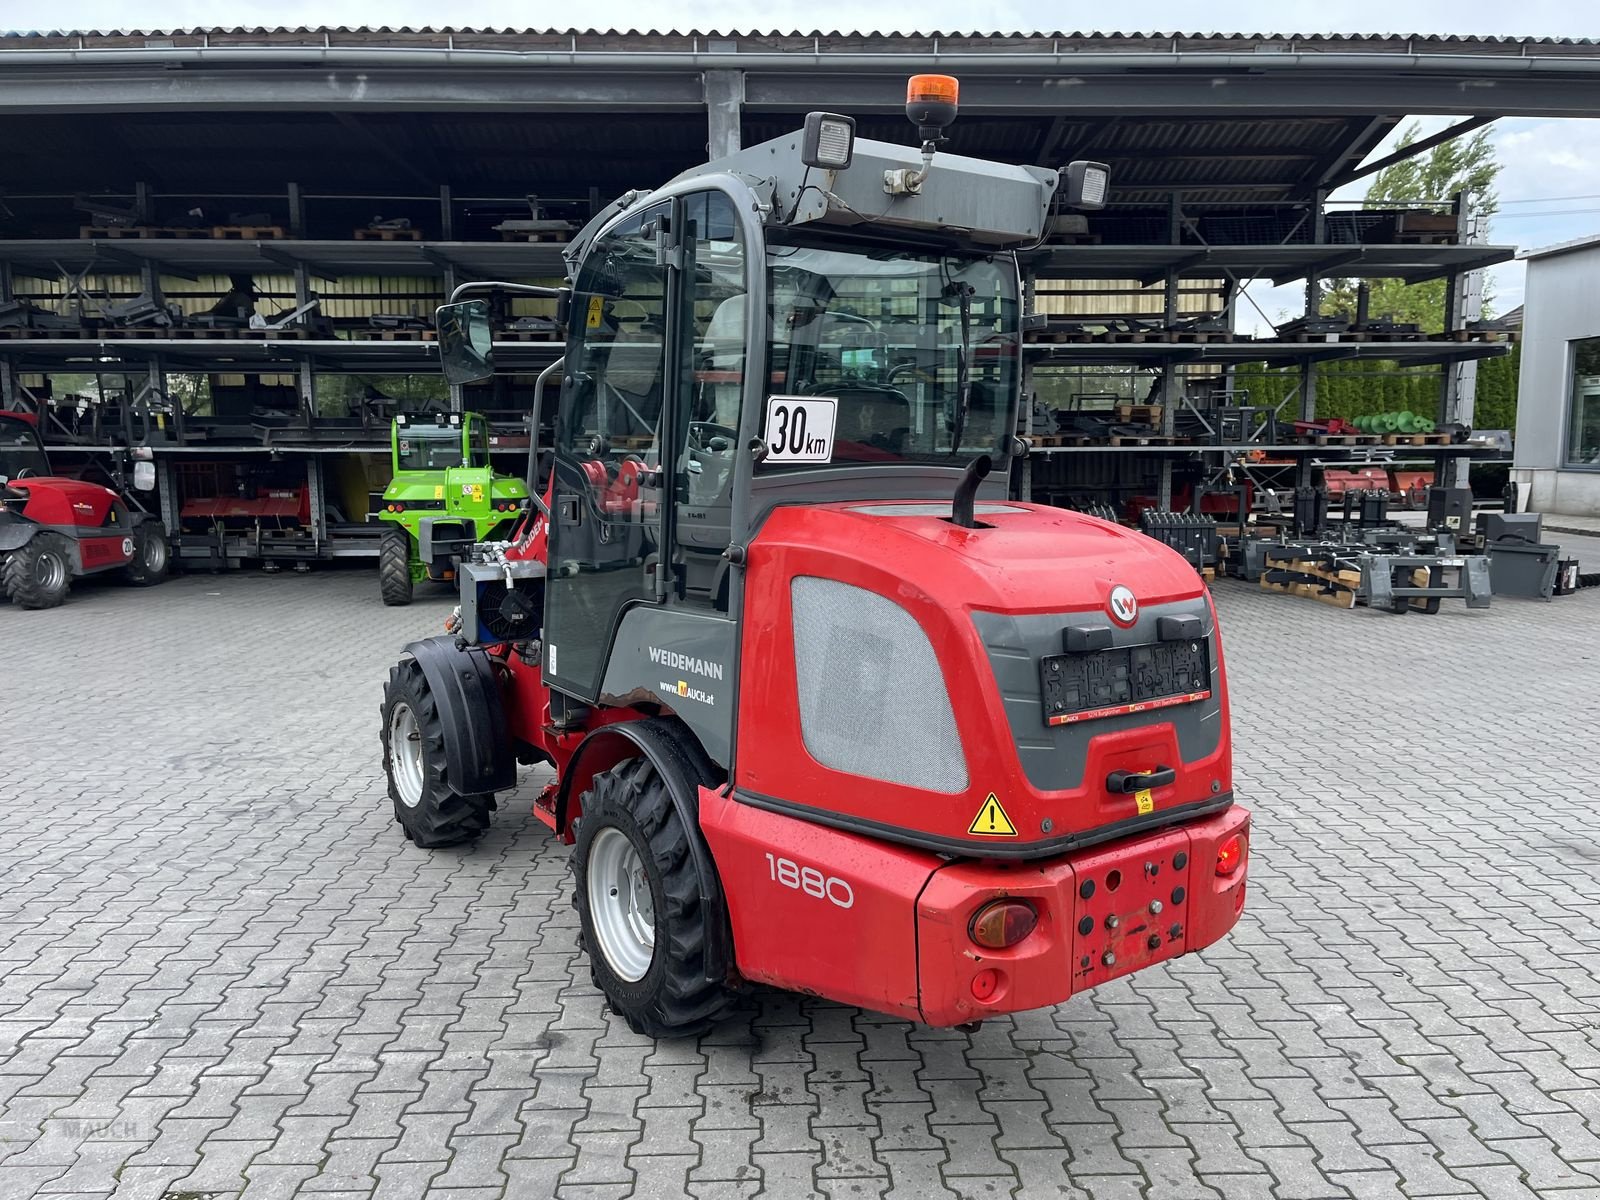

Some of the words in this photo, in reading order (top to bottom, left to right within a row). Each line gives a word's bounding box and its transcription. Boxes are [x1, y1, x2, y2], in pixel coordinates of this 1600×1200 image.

[770, 404, 807, 455] 30
[804, 432, 826, 455] km
[124, 540, 132, 553] 20
[648, 646, 723, 681] WEIDEMANN
[659, 681, 715, 706] www.MAUCH.at
[765, 852, 855, 909] 1880
